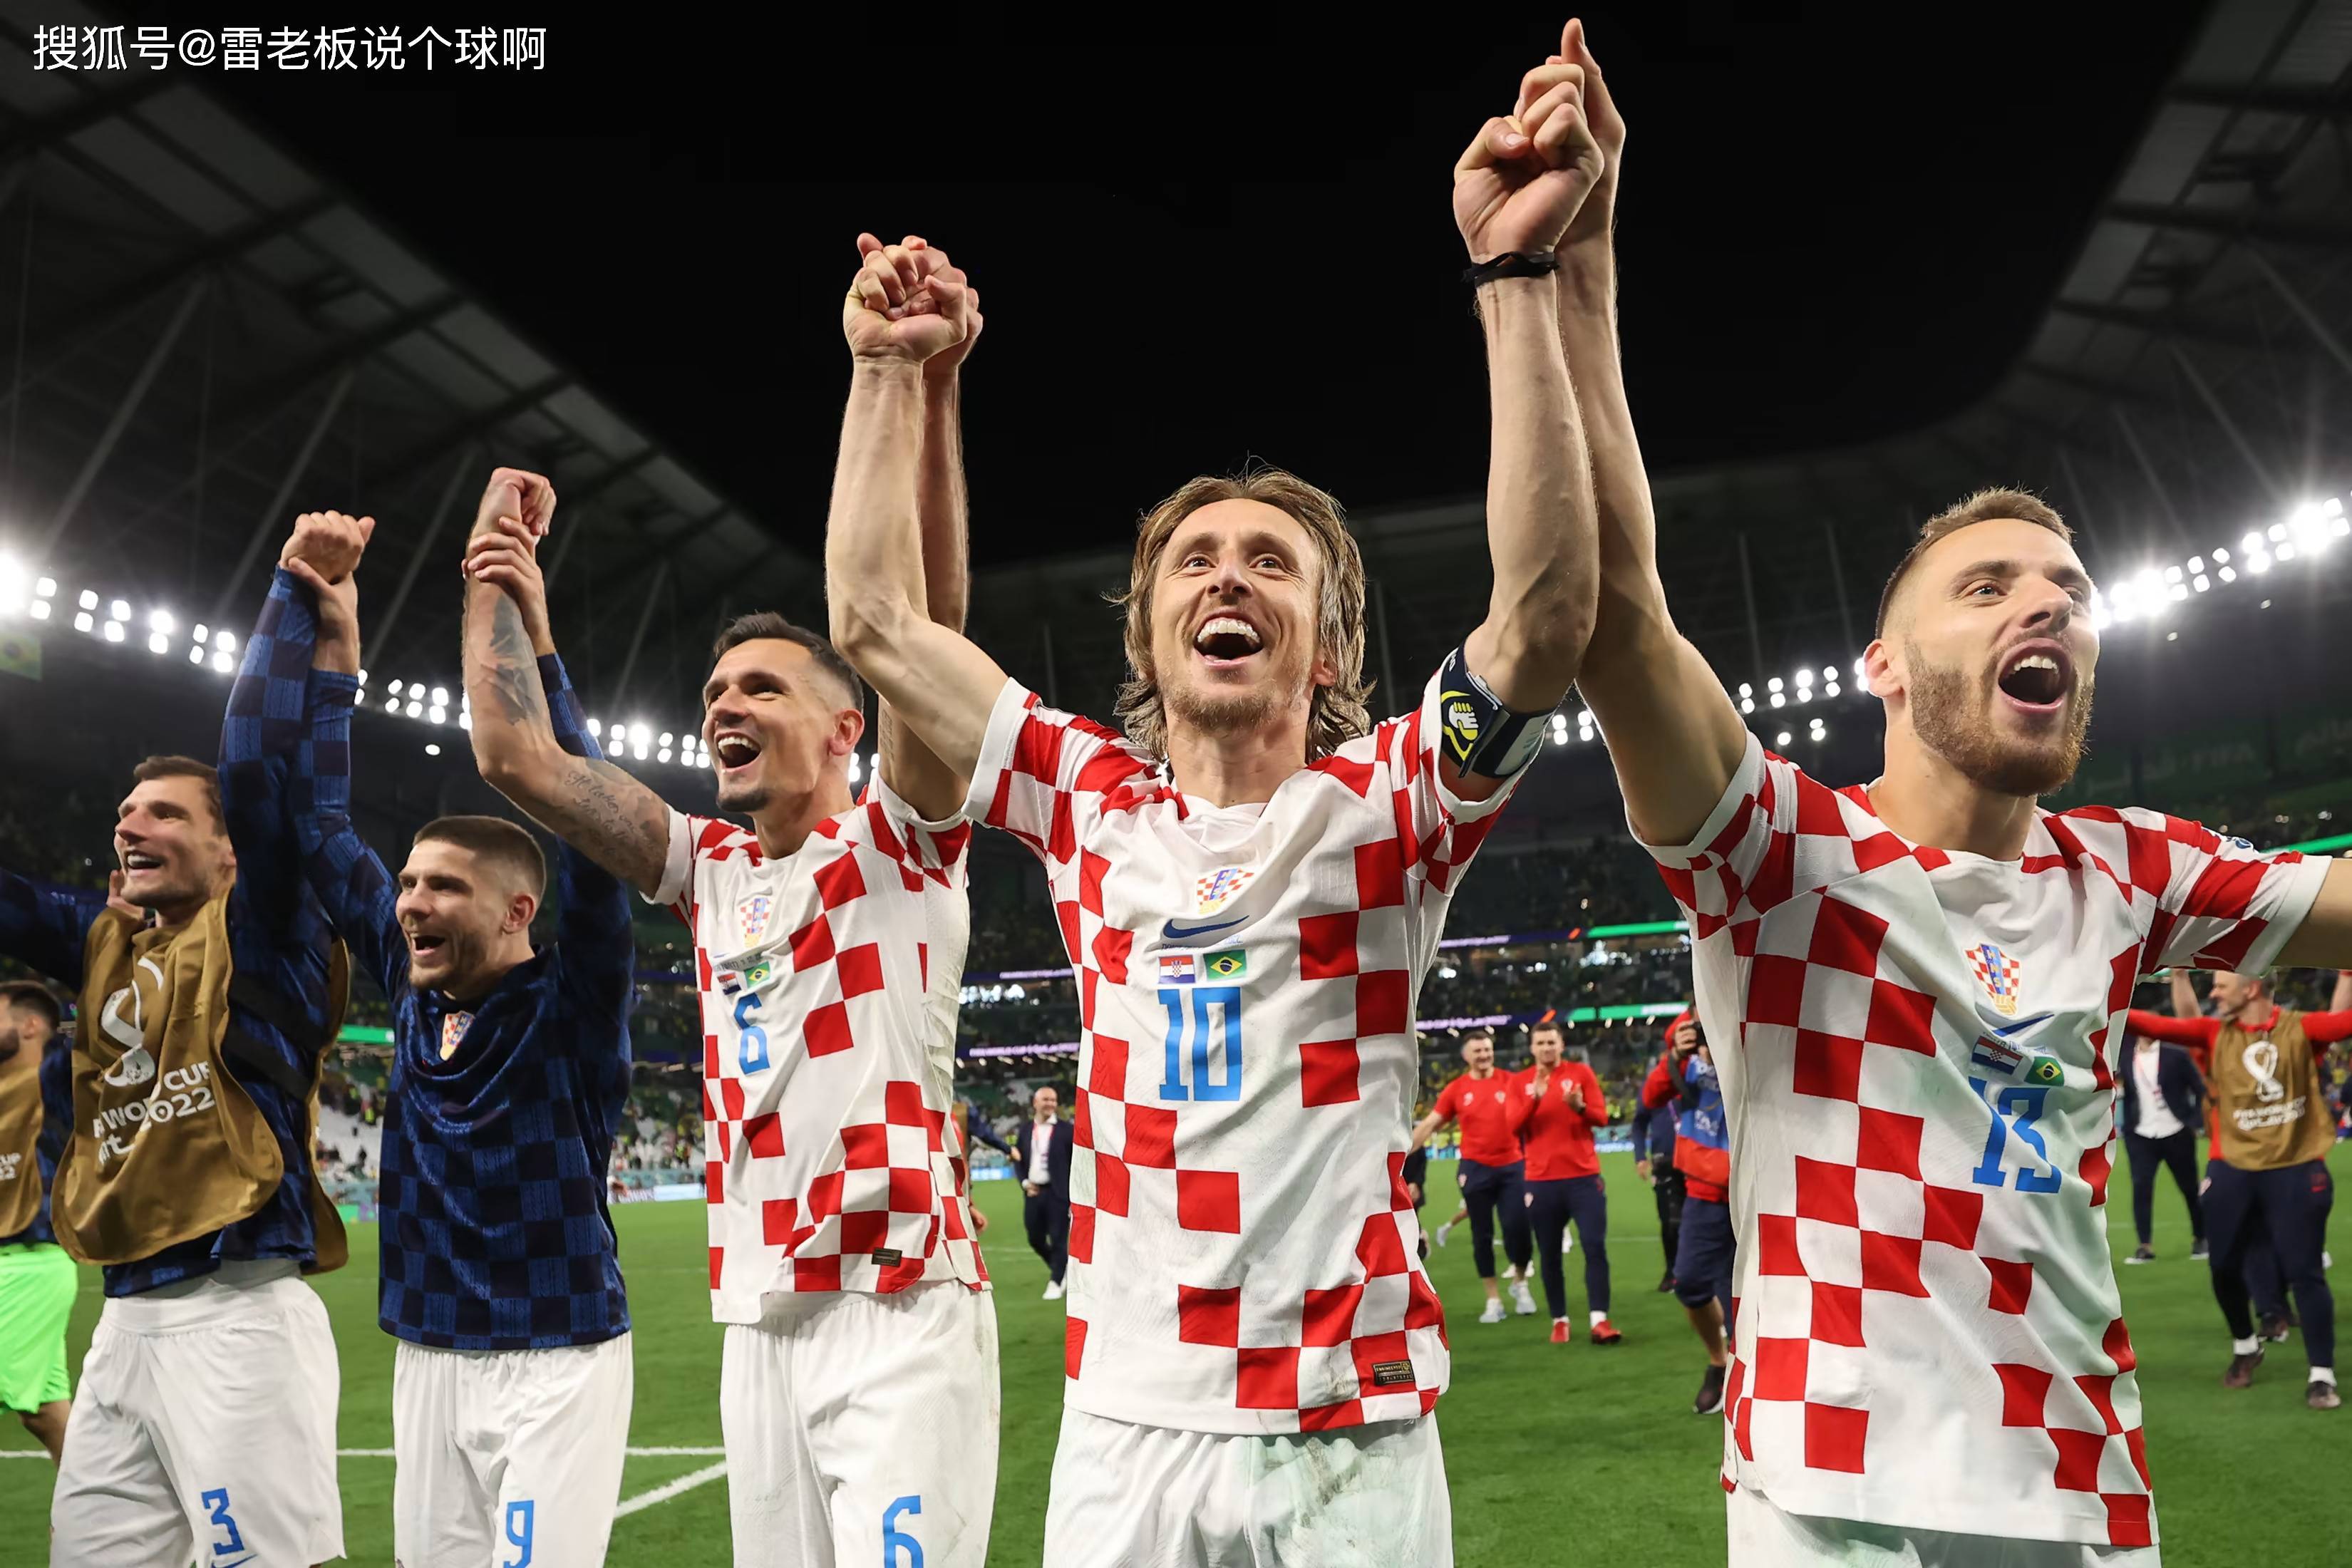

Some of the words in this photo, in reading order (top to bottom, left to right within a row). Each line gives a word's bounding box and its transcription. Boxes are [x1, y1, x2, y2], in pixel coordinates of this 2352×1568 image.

[733, 993, 770, 1076] 6
[1157, 986, 1242, 1101] 10
[1968, 1076, 2062, 1194] 13
[201, 1487, 245, 1555] 3
[503, 1500, 534, 1568] 9
[882, 1494, 924, 1568] 6
